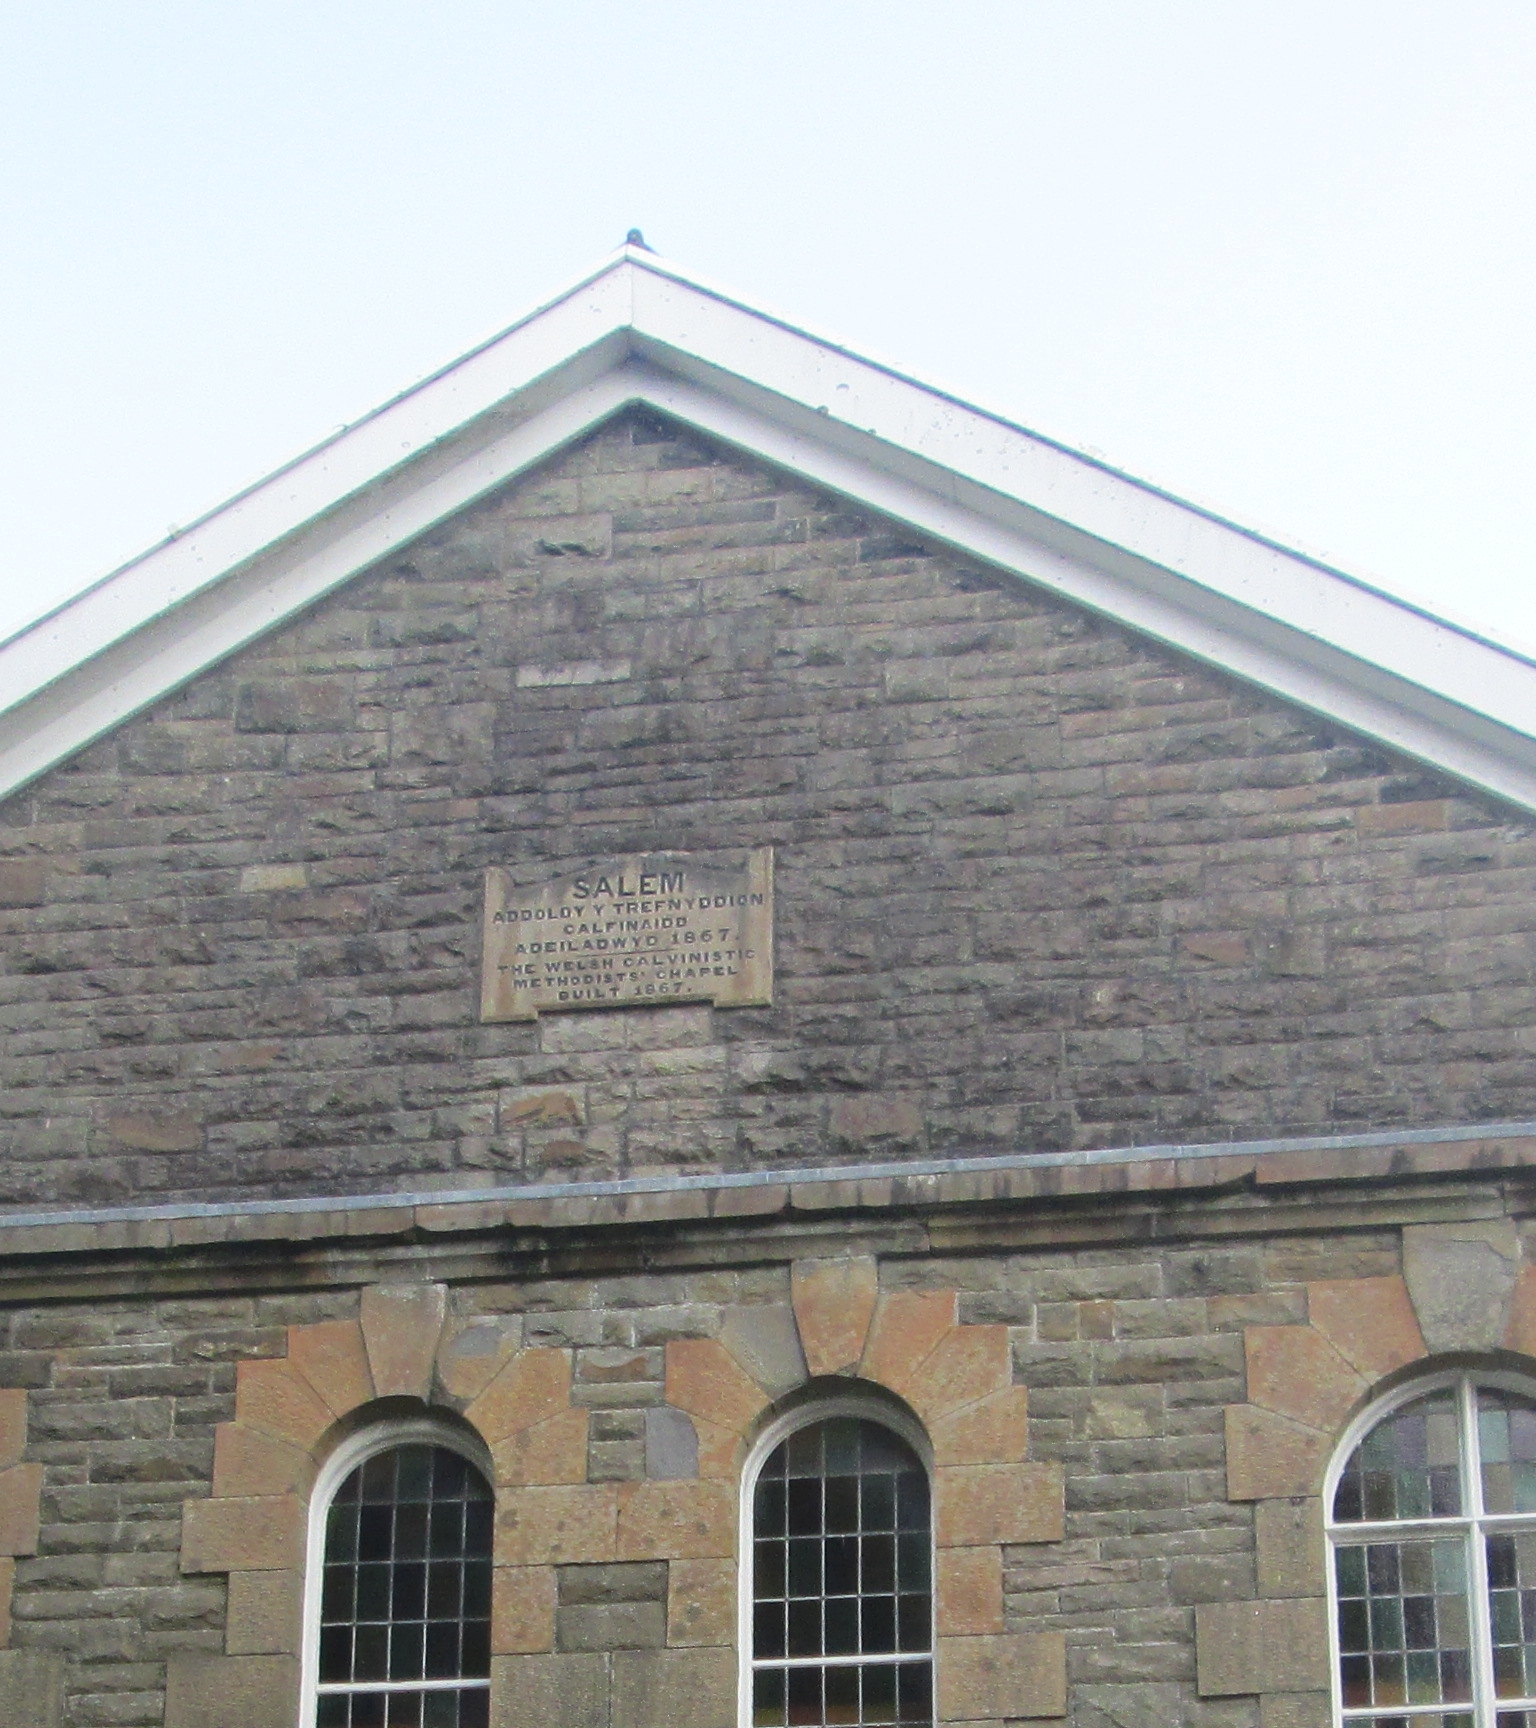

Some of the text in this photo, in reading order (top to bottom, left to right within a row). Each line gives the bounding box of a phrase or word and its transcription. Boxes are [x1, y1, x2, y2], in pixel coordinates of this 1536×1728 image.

[573, 872, 684, 899] SALEM
[593, 903, 605, 917] Y
[613, 893, 764, 915] TREFNYDDION
[564, 917, 688, 935] CALFINAIDD
[516, 936, 658, 954] ADEILADWYD
[498, 950, 756, 976] THE WELSH CALVINISTIC
[514, 965, 738, 989] METHODISTS' CHAPEL
[559, 987, 620, 1001] BUILT
